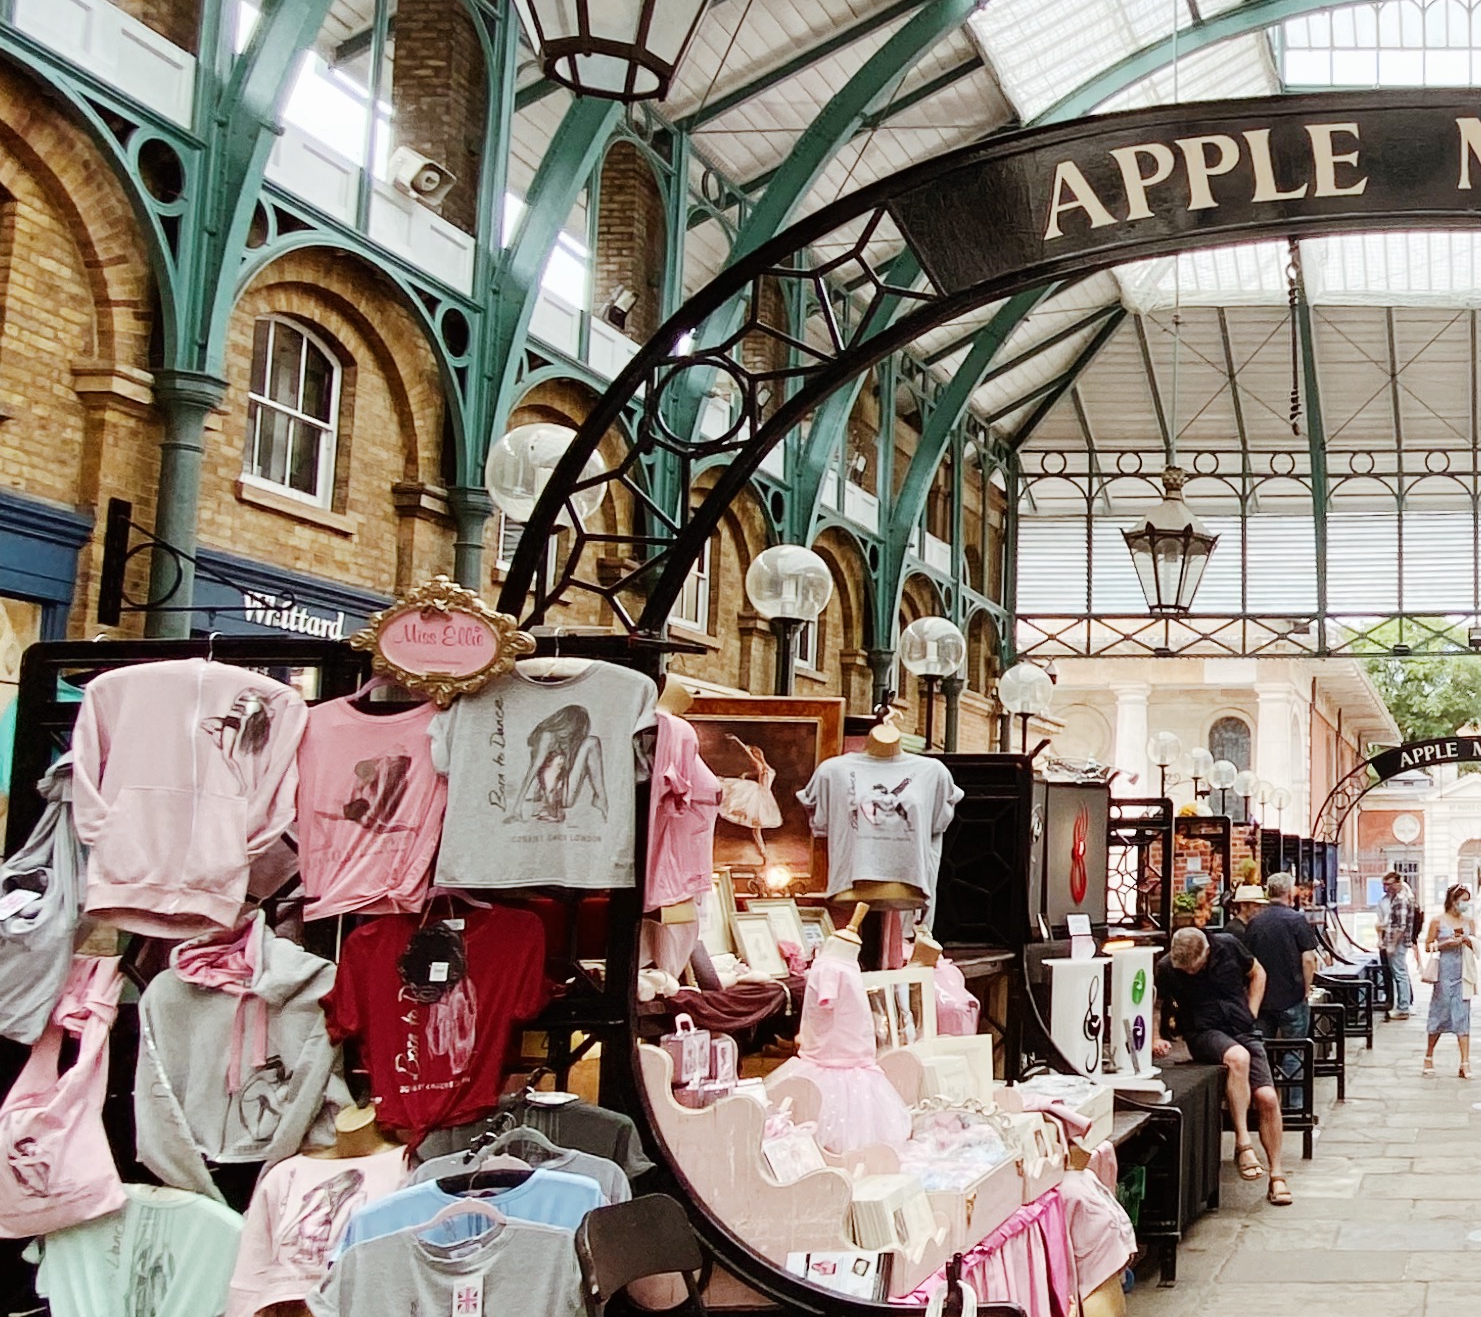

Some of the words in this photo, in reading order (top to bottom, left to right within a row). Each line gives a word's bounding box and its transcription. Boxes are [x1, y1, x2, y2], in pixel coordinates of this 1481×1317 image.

[1043, 122, 1369, 241] APPLE
[243, 589, 346, 642] Whittard
[394, 623, 437, 646] Miss
[441, 624, 484, 647] Ellie
[489, 695, 506, 750] Dance
[492, 752, 506, 767] to
[1399, 741, 1459, 769] APPLE
[488, 773, 507, 814] Born
[400, 1009, 420, 1026] to
[394, 1032, 421, 1081] Born
